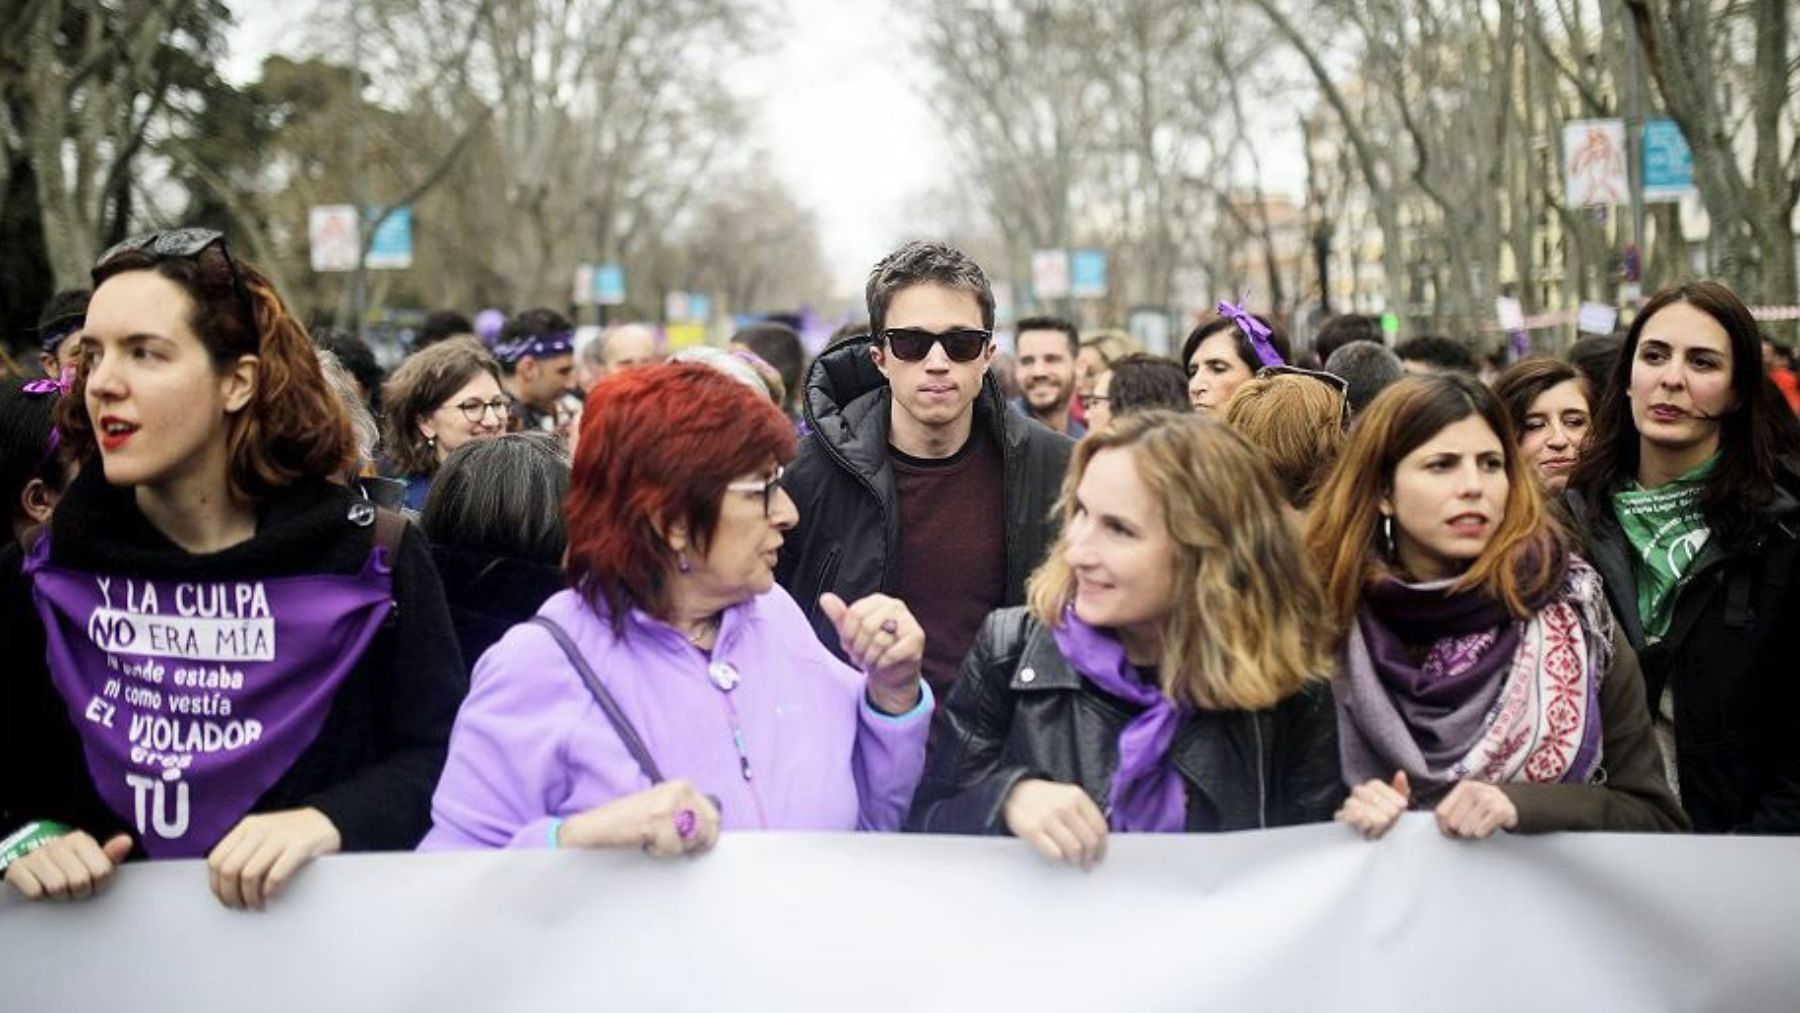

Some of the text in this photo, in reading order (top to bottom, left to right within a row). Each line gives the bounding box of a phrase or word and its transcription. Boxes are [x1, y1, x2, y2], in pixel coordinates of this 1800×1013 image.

[97, 576, 270, 618] Y LA CULPA
[93, 614, 268, 656] NO ERA MÍA
[174, 665, 244, 690] estaba
[124, 686, 162, 710] como
[168, 692, 231, 716] vestía
[85, 695, 262, 753] EL VIOLADOR
[126, 768, 189, 839] TÚ
